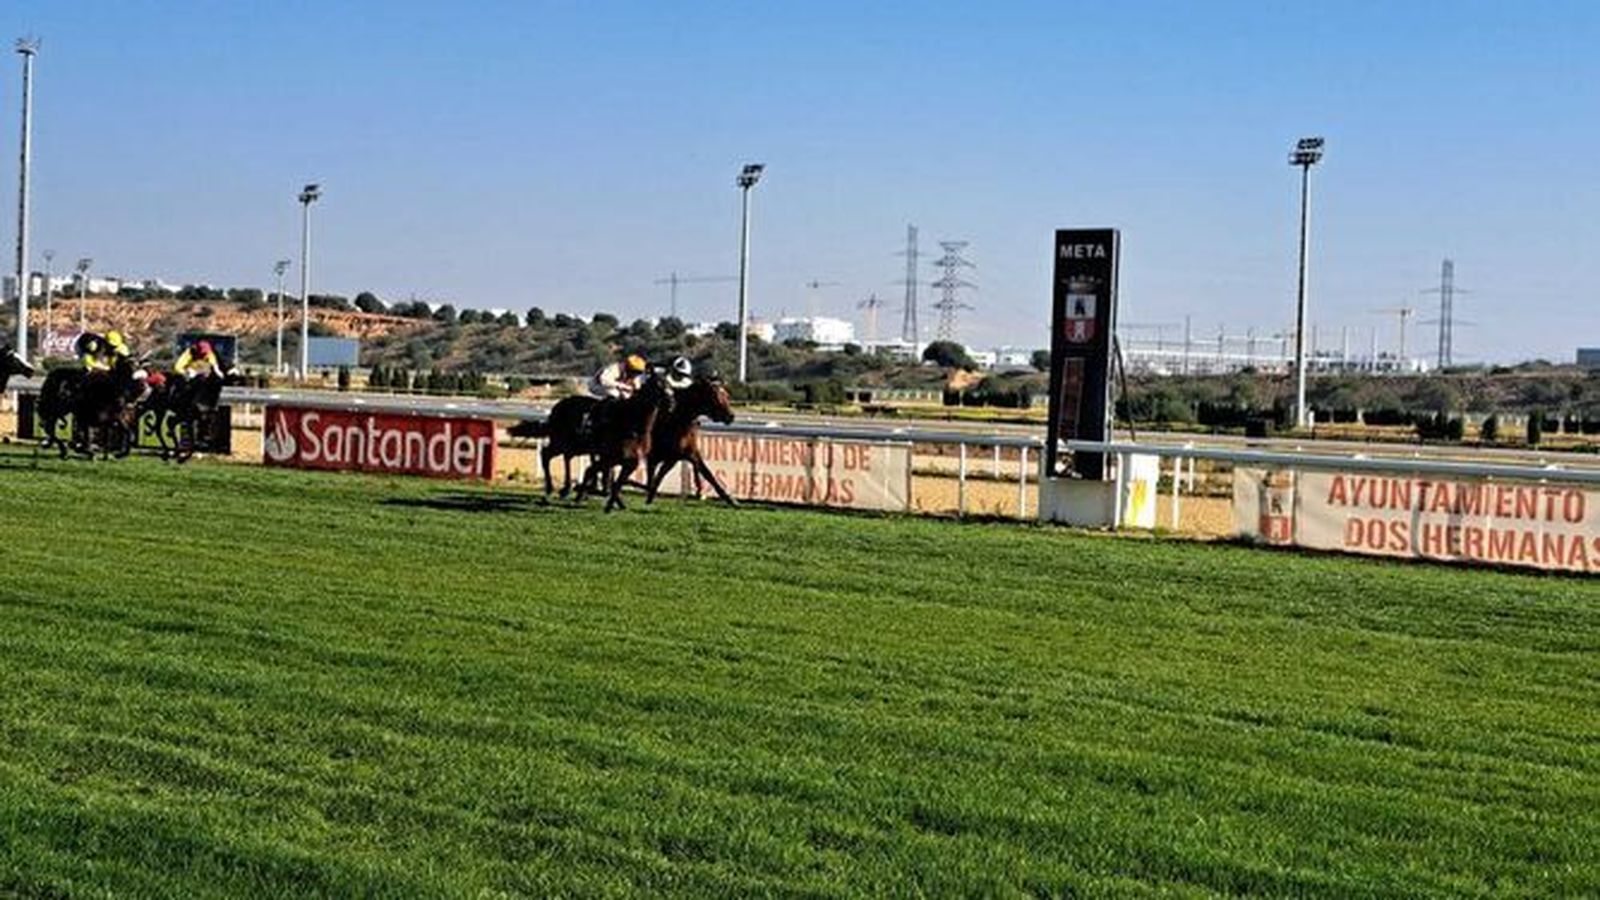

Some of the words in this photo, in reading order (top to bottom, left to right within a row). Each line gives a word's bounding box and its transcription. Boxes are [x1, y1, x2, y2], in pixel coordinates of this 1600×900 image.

[1061, 245, 1106, 258] META
[300, 413, 491, 474] Santander
[700, 436, 833, 468] UNTAMIENTO
[844, 444, 872, 472] DE
[735, 472, 855, 504] HERMANAS
[1328, 476, 1585, 523] AYUNTAMIENTO
[1345, 518, 1409, 551] DOS
